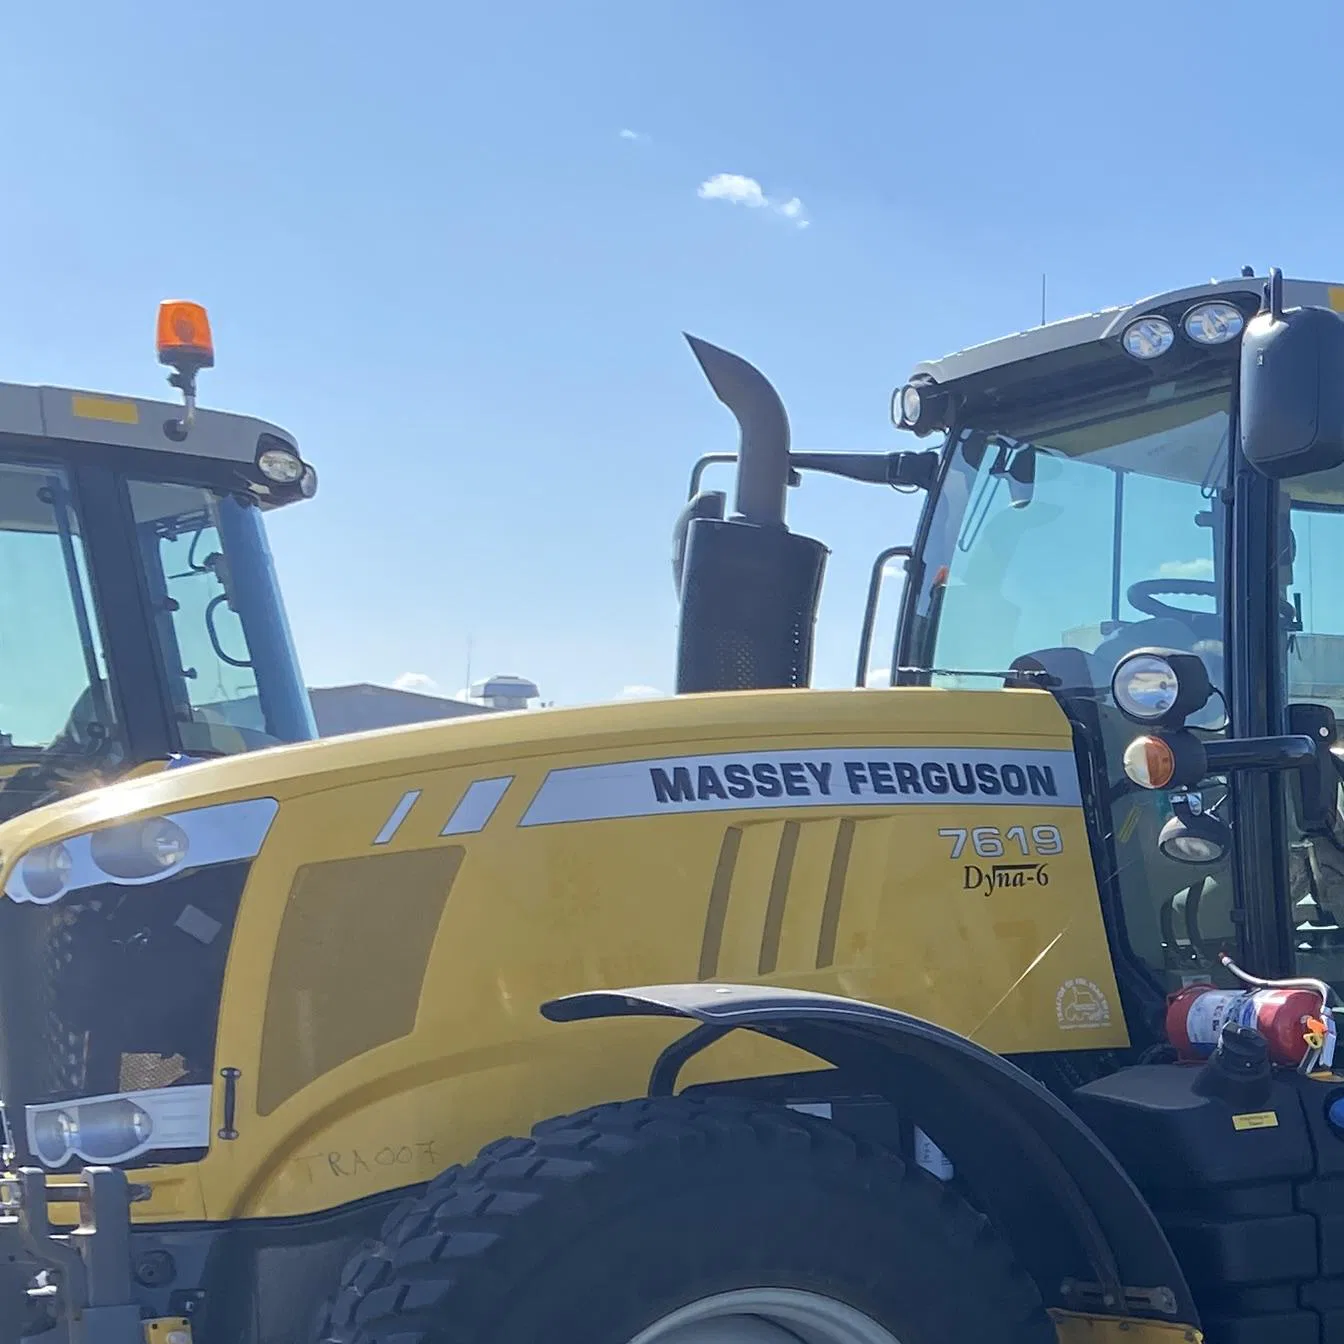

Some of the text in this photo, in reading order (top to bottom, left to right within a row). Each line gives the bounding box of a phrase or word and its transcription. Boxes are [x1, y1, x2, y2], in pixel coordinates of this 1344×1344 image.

[649, 761, 1058, 803] MASSEY FERGUSON
[938, 824, 1064, 860] 7619
[963, 863, 1049, 896] Dyna-6
